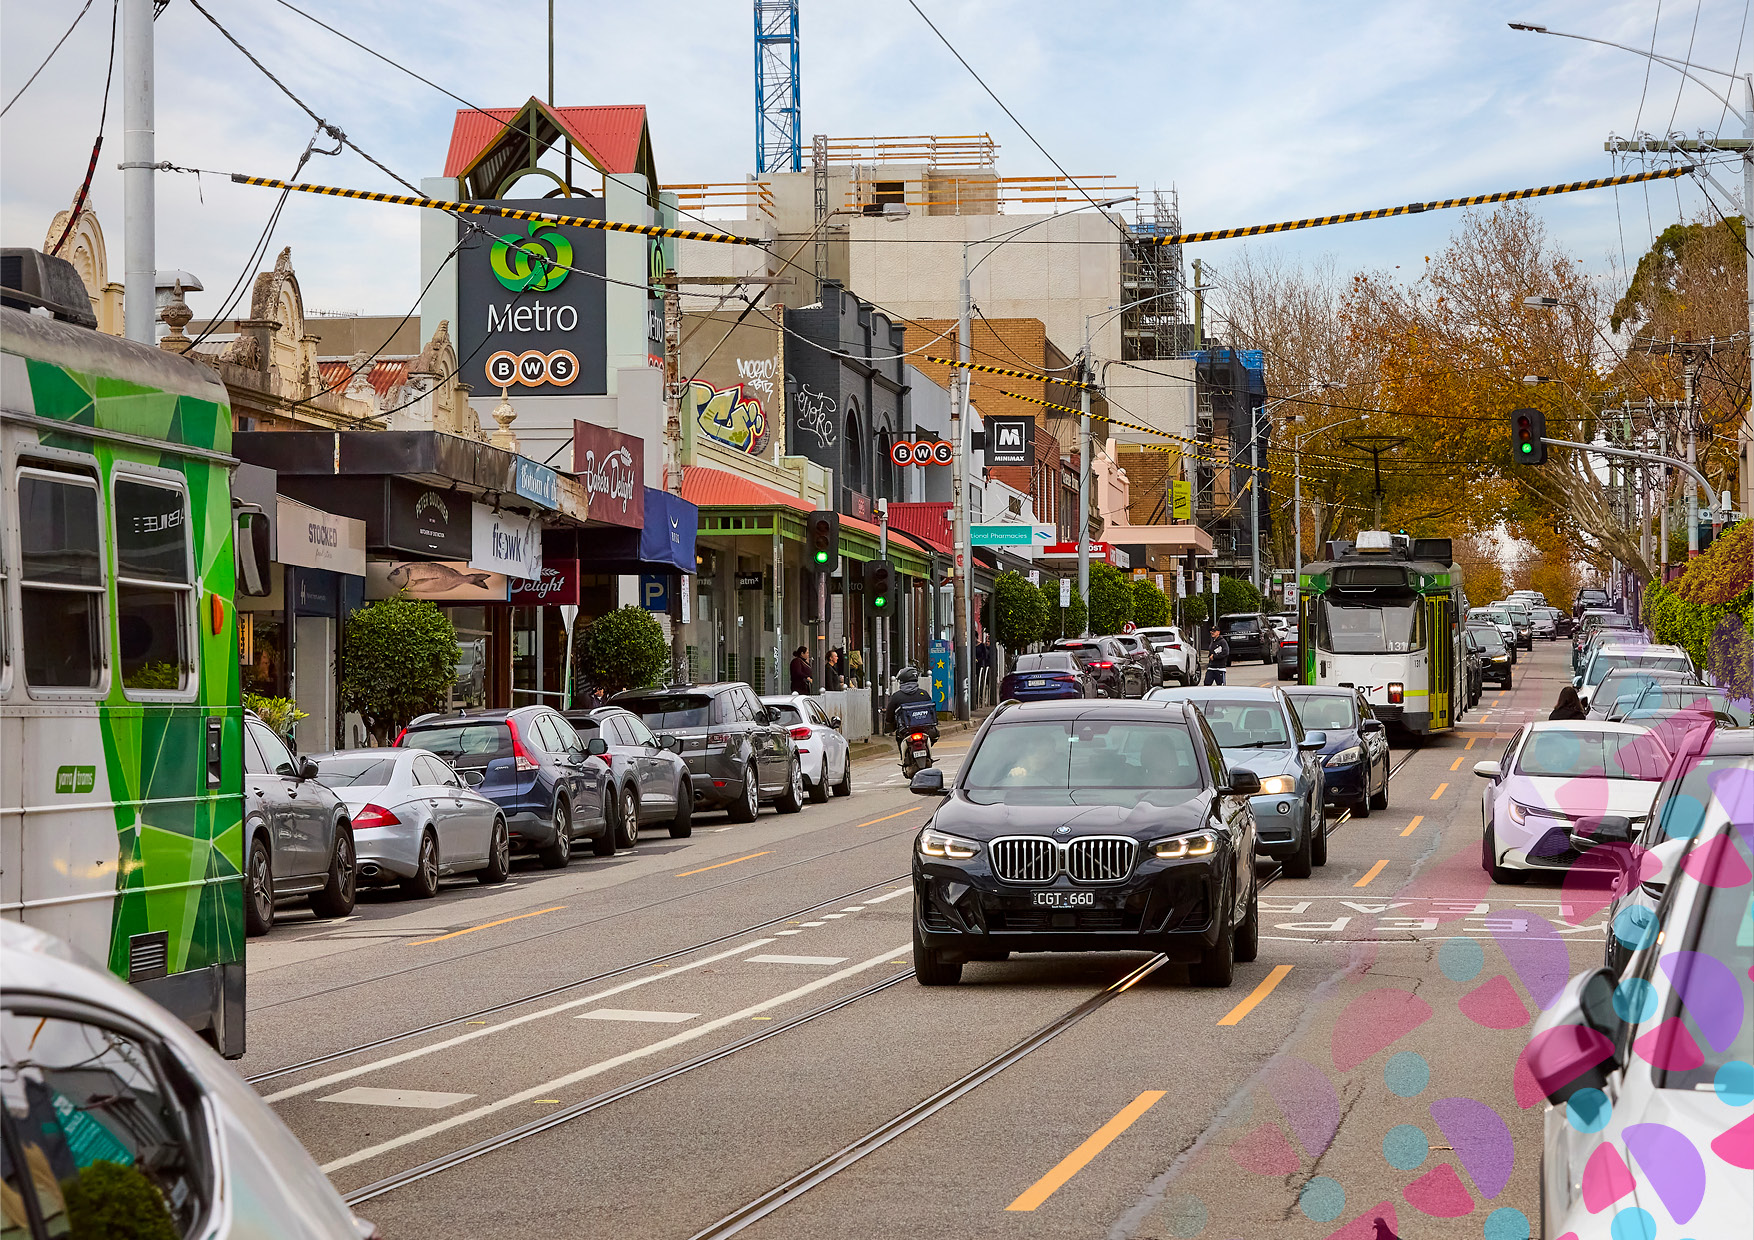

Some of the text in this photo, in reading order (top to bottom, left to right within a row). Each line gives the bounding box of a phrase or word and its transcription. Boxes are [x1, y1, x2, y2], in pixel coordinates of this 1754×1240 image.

[487, 300, 578, 332] Metro
[498, 361, 567, 376] BWS
[998, 428, 1021, 446] M
[899, 448, 947, 459] BWS
[521, 463, 543, 496] Bottom
[586, 450, 635, 513] Bakers Delight
[308, 523, 338, 548] STOCKED
[511, 576, 565, 599] Delight
[645, 582, 664, 607] P
[1388, 641, 1409, 651] 131
[58, 770, 93, 790] yarra trams
[1037, 892, 1094, 905] CGT 660
[1258, 901, 1609, 917] LEAR
